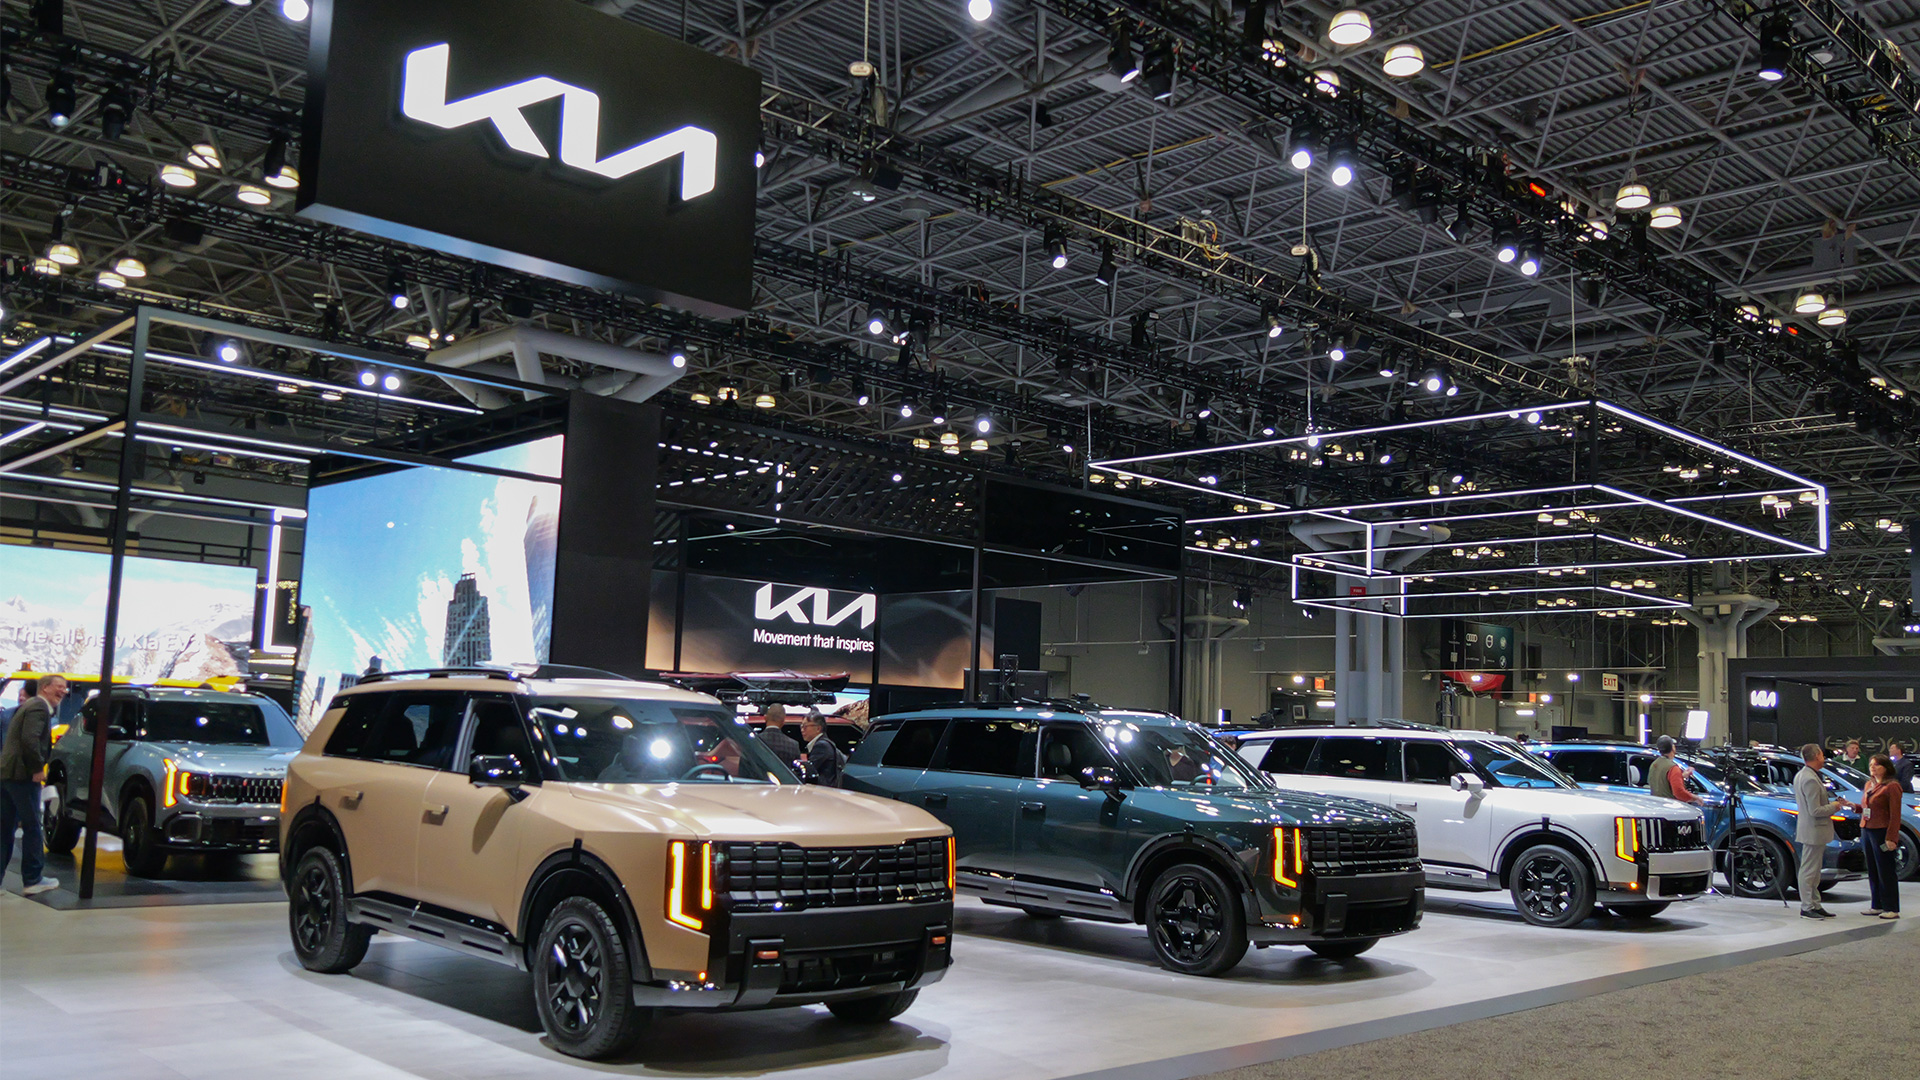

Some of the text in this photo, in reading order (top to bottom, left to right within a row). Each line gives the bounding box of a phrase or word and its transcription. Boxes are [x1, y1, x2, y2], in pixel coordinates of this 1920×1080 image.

[403, 42, 717, 201] KIA
[755, 582, 876, 630] KIA
[10, 624, 47, 644] The
[131, 633, 160, 651] Kia
[753, 628, 875, 653] Movement that inspires
[1604, 677, 1617, 688] EXIT
